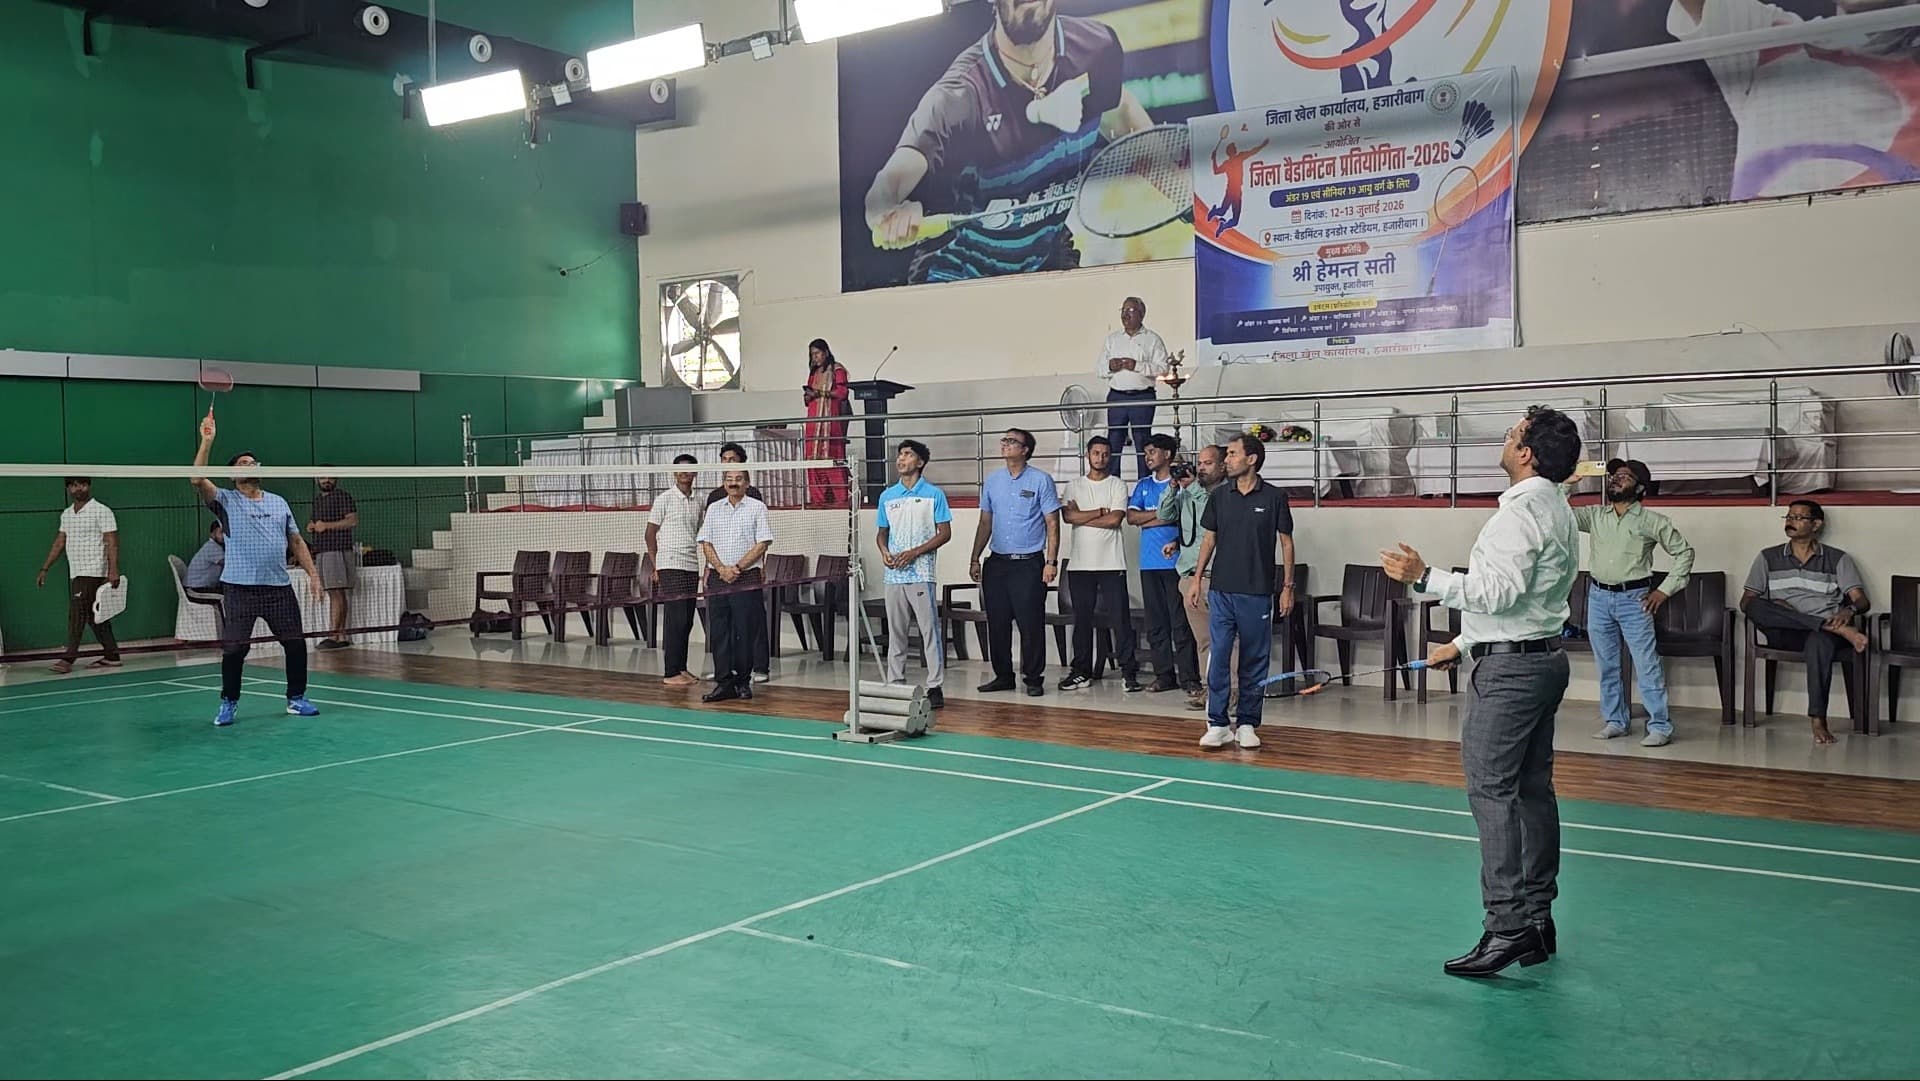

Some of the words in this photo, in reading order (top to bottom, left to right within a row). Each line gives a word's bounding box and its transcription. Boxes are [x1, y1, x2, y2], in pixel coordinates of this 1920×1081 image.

[1266, 110, 1291, 126] जिला
[1295, 104, 1316, 121] खेल
[1320, 98, 1369, 118] कार्यालय,
[1373, 88, 1425, 111] हजारीबाग
[1324, 118, 1335, 132] की
[1337, 118, 1351, 130] ओर
[1353, 116, 1361, 128] से
[1324, 135, 1360, 149] आयोजित
[1249, 160, 1281, 188] जिला
[1284, 153, 1336, 184] बैडमिंटन
[1285, 192, 1299, 203] अंडर
[1301, 191, 1309, 200] 19
[1310, 188, 1321, 199] एवं
[1322, 185, 1346, 198] सीनियर
[1348, 185, 1356, 195] 19
[1358, 183, 1373, 196] आयु
[1374, 180, 1385, 192] वर्ग
[1386, 179, 1395, 190] के
[1396, 178, 1411, 190] लिए
[1304, 209, 1328, 221] दिनांक:
[1330, 206, 1354, 218] 12-13
[1356, 202, 1380, 218] जुलाई
[1383, 201, 1404, 213] 2026
[1294, 227, 1323, 241] बैडमिंटन
[1325, 225, 1347, 238] इनडोर
[1292, 260, 1312, 281] श्री
[1316, 258, 1359, 281] हेमन्त
[1364, 251, 1396, 275] सती
